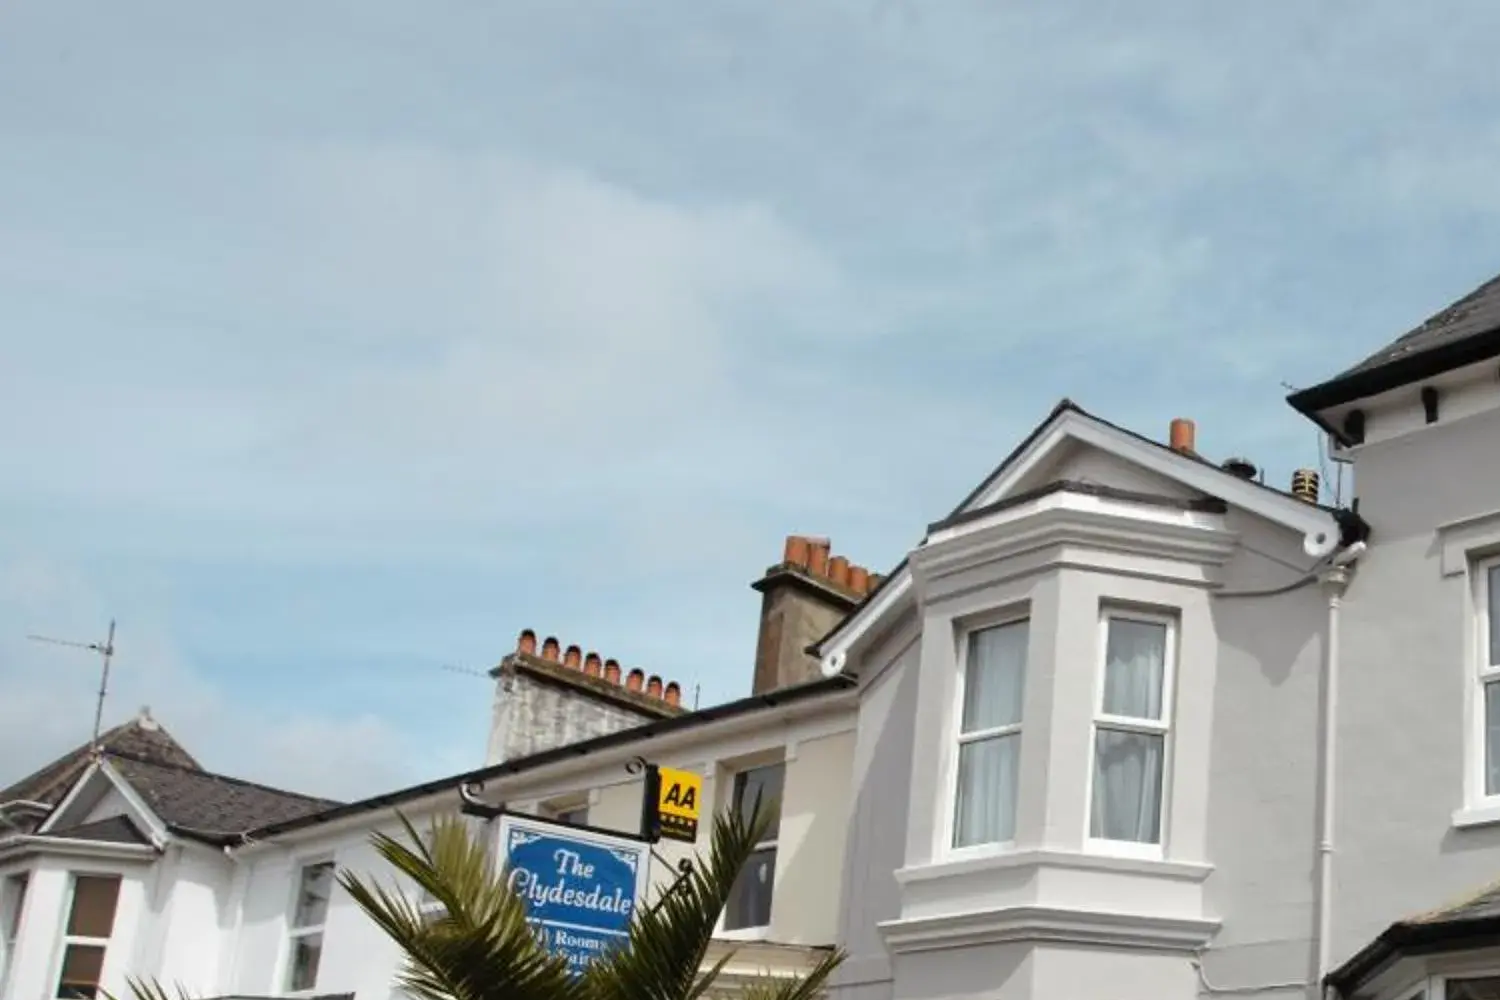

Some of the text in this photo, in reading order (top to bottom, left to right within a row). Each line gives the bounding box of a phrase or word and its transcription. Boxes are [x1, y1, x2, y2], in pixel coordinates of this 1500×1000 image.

[663, 783, 696, 810] AA
[554, 849, 594, 879] The
[508, 867, 632, 914] Clydesdale
